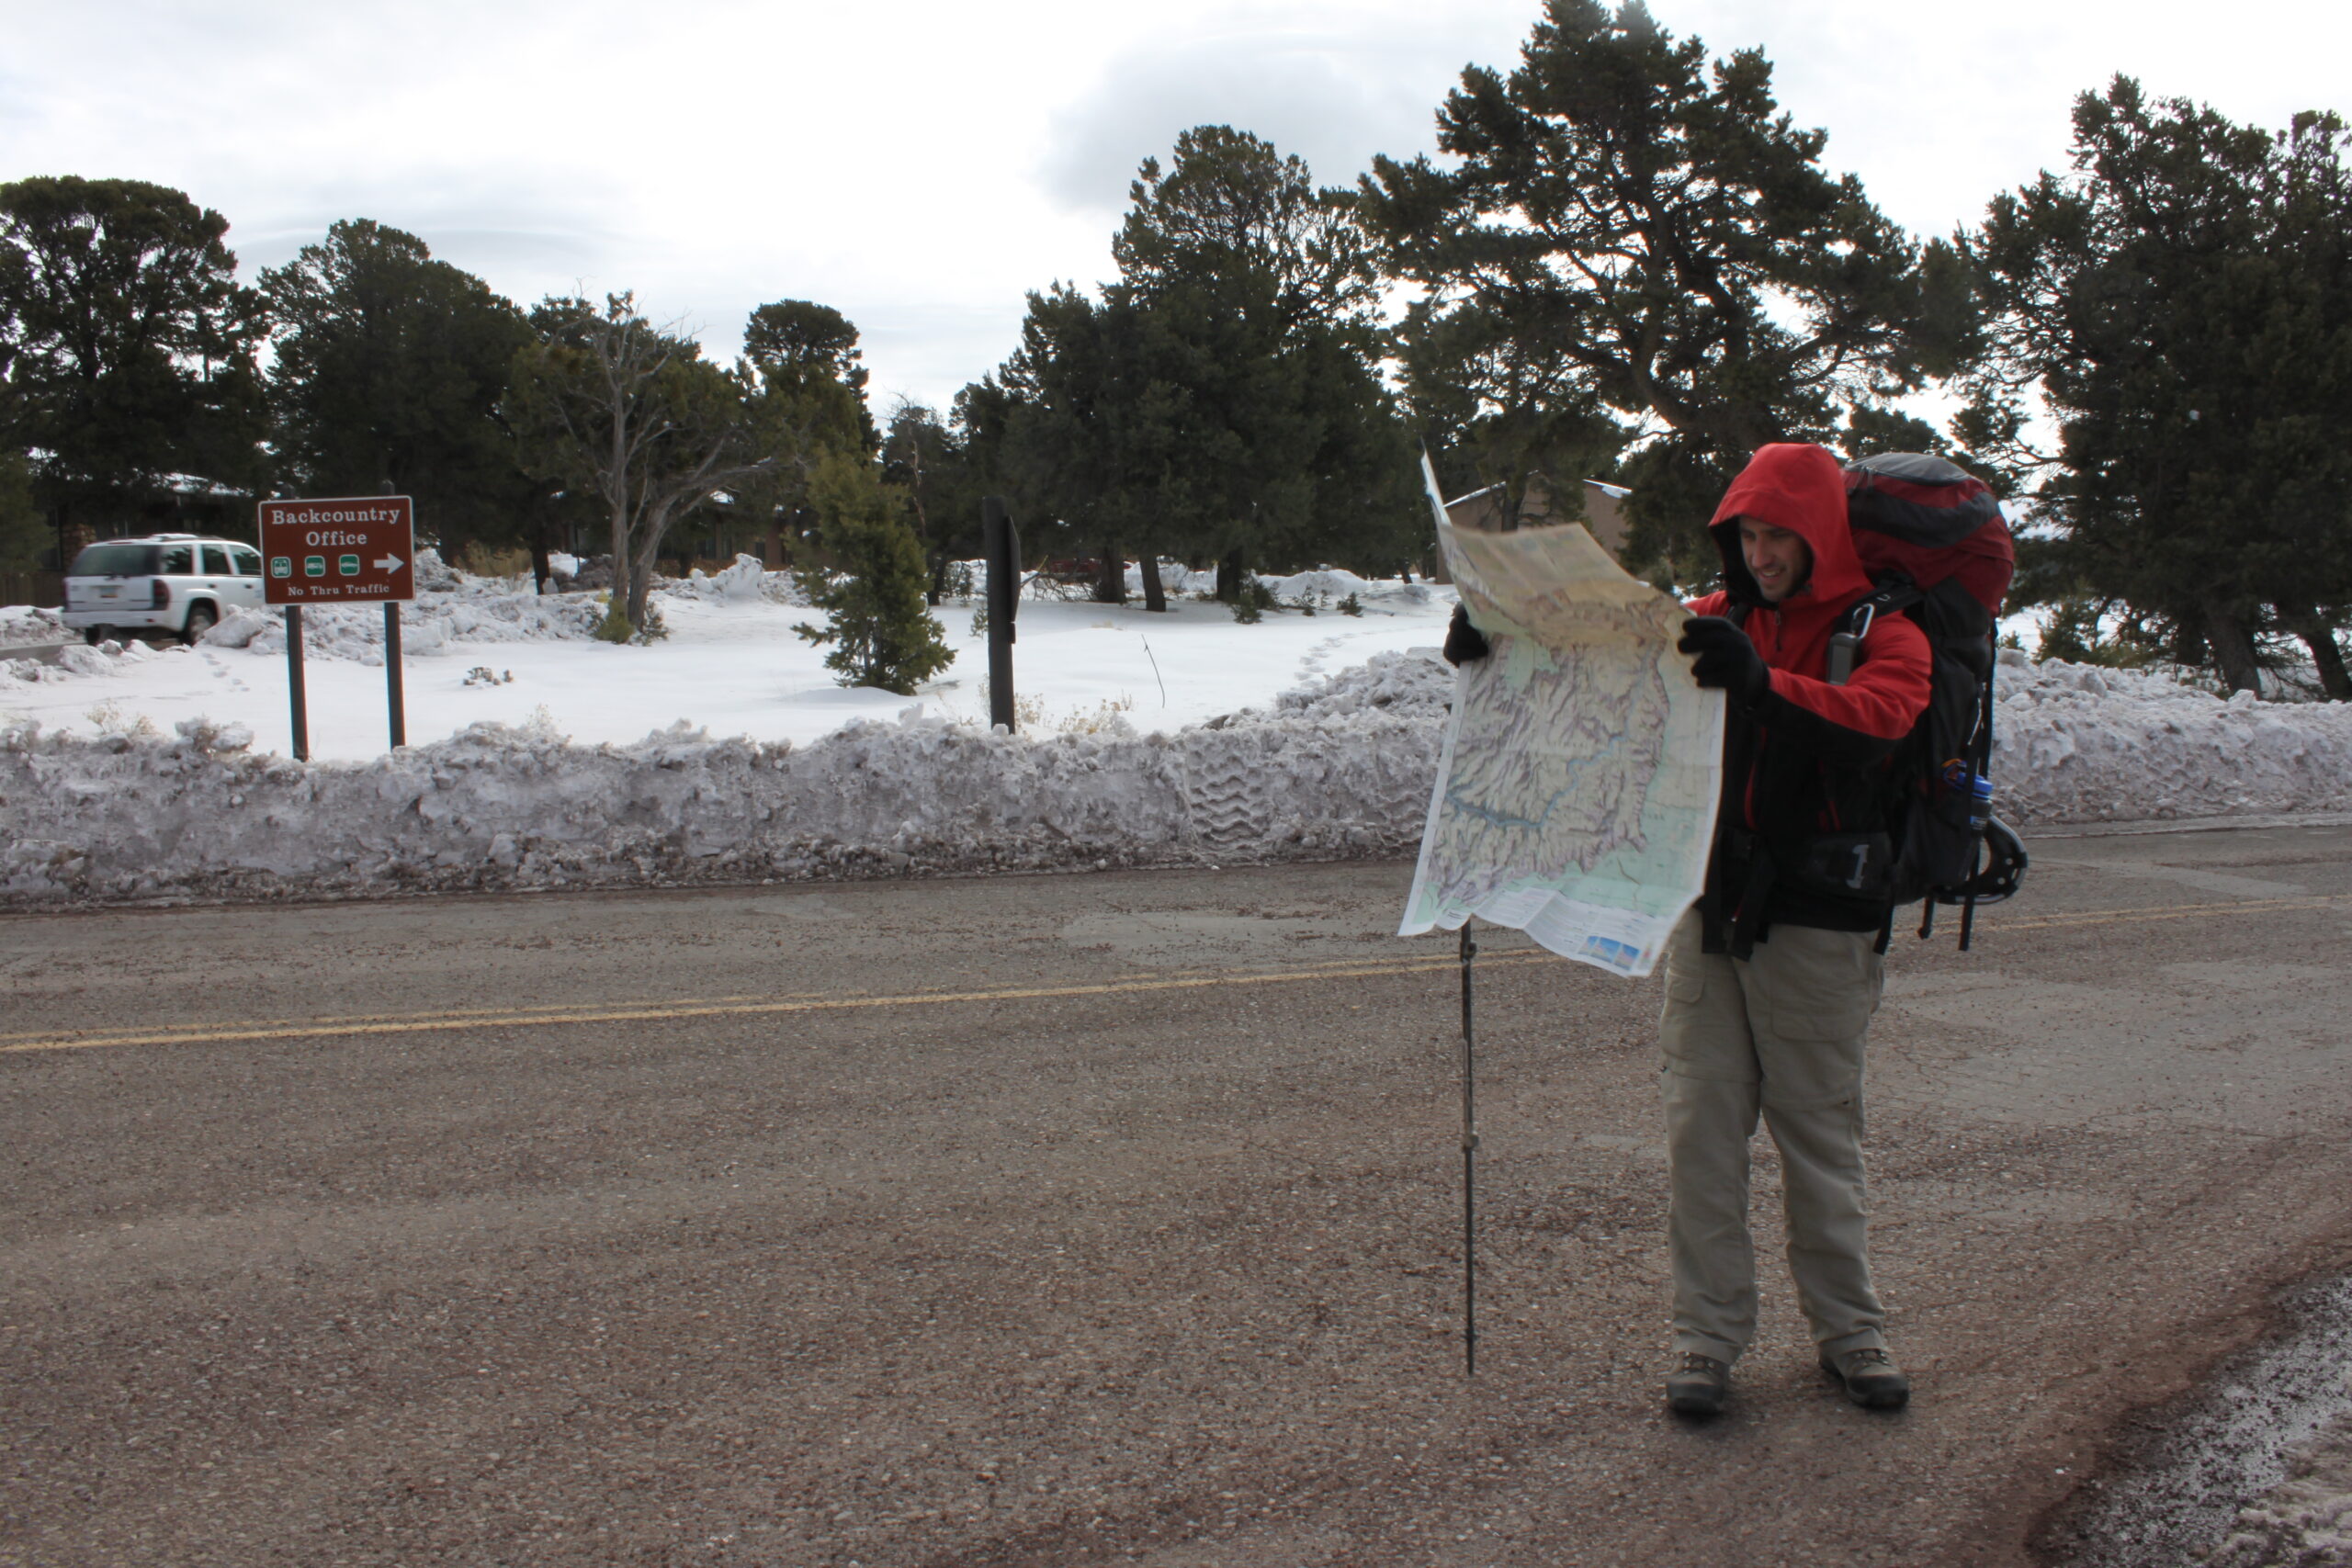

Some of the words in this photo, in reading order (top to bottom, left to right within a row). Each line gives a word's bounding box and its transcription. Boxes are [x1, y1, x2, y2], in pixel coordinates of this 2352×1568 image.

[271, 508, 401, 525] Backcountry
[305, 530, 368, 547] Office
[288, 586, 304, 596] No
[310, 585, 340, 595] Thru
[345, 583, 390, 594] Traffic
